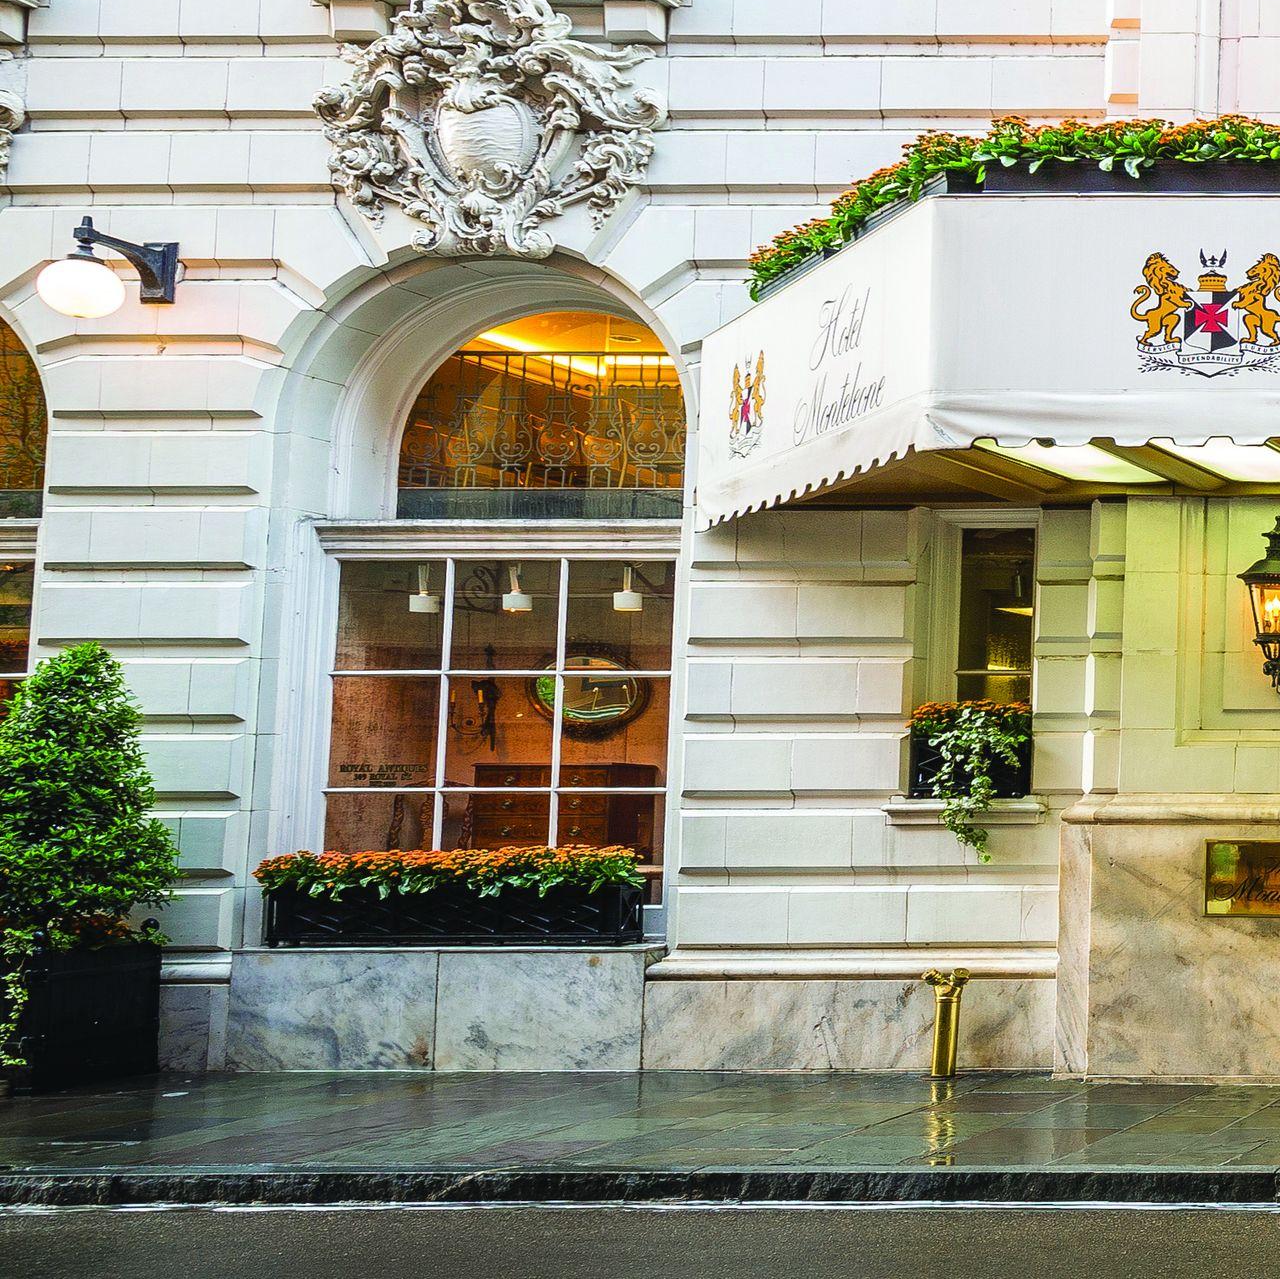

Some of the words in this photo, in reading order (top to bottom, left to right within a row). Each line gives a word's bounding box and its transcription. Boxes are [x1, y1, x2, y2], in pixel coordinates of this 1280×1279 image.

[809, 282, 870, 371] Hotel
[1142, 343, 1177, 353] SERVICE
[1244, 344, 1280, 353] LUXURY
[1182, 355, 1240, 363] DEPENDABILITY
[793, 361, 886, 447] Monteleone
[340, 764, 373, 773] ROYAL
[378, 764, 428, 773] ANTIQUES
